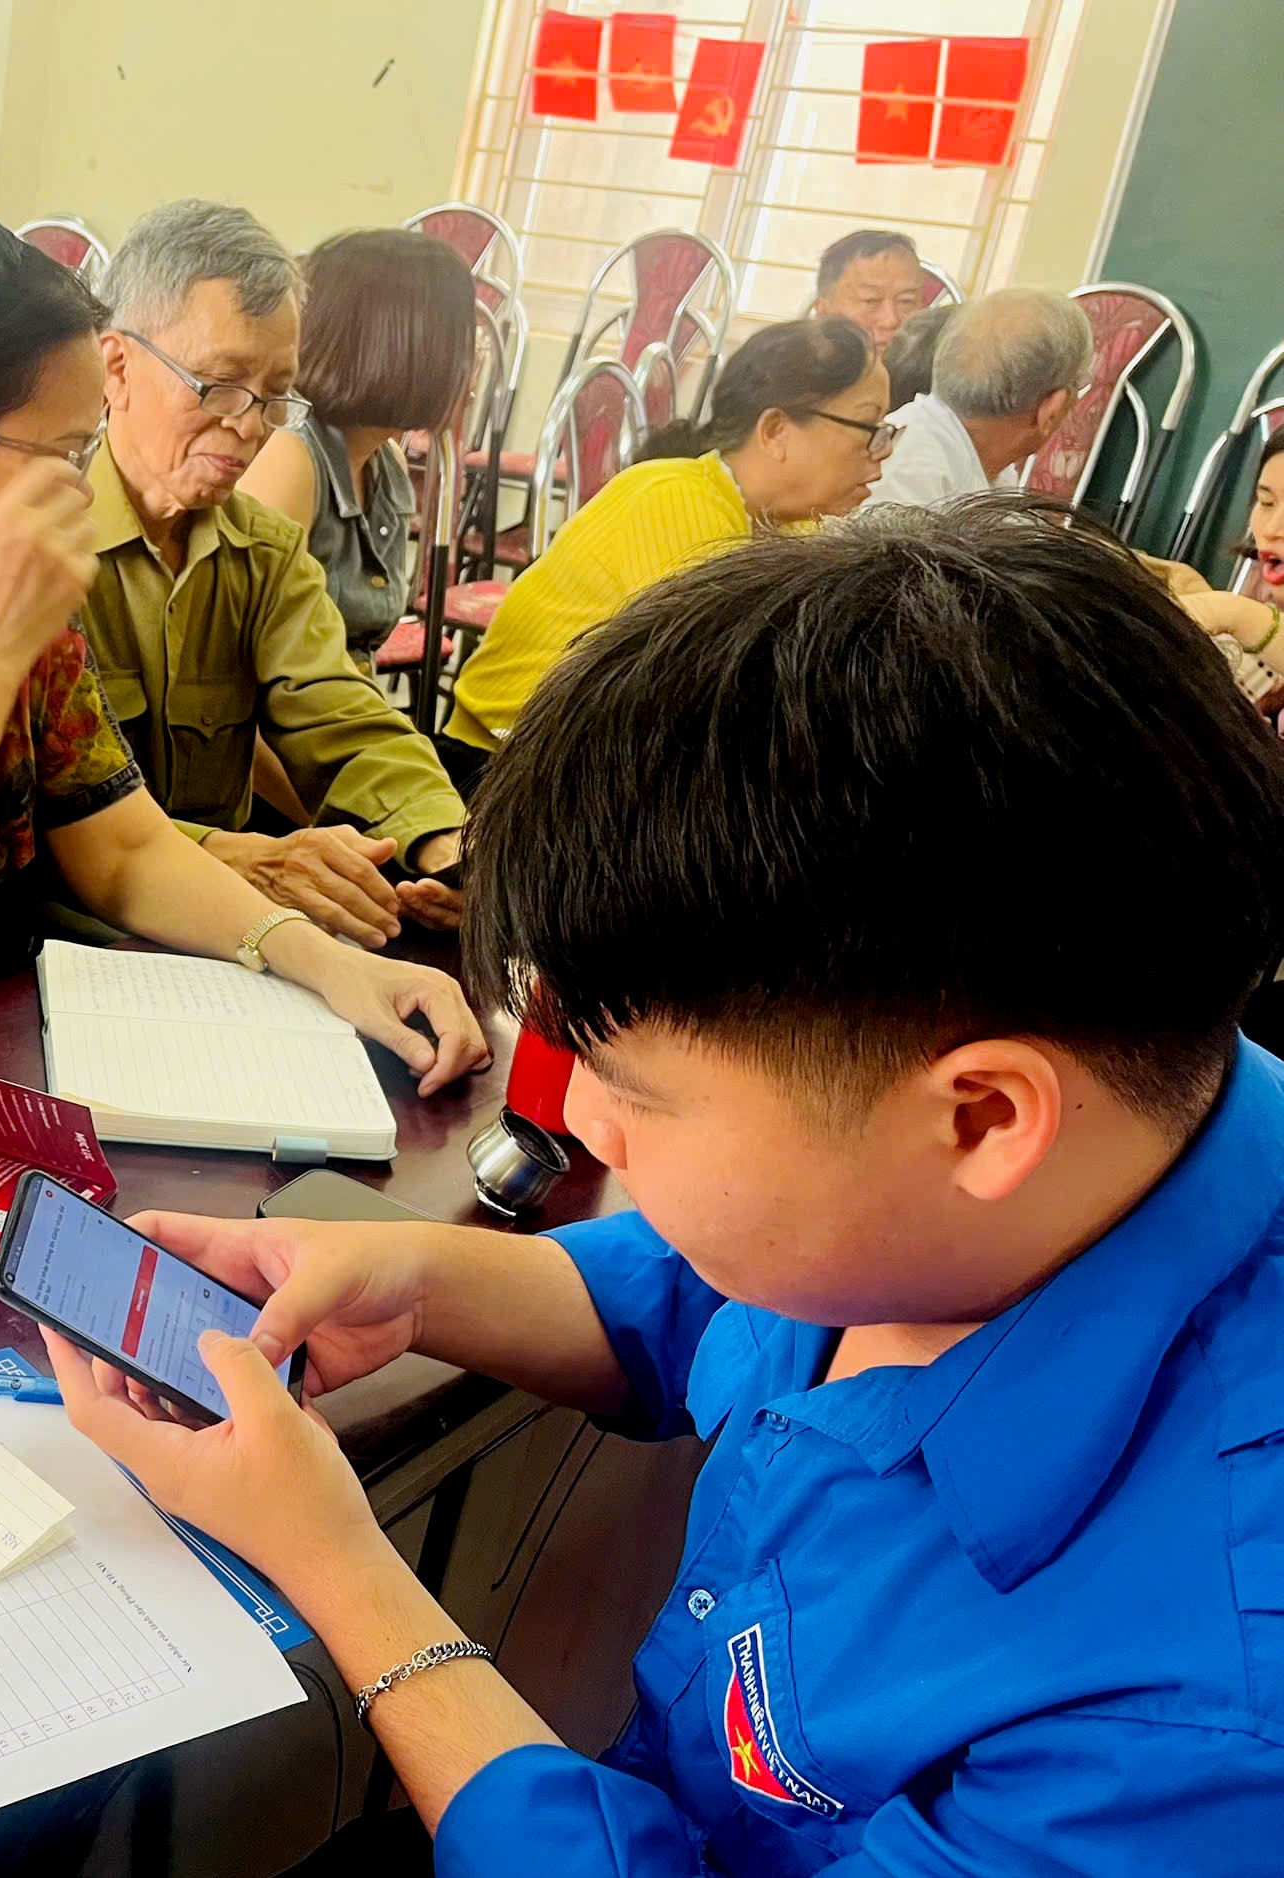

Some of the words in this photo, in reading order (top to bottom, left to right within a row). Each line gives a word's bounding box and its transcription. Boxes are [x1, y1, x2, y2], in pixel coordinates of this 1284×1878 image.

[737, 1633, 758, 1702] THANH
[750, 1694, 767, 1741] NIÊN
[785, 1777, 828, 1813] NAM
